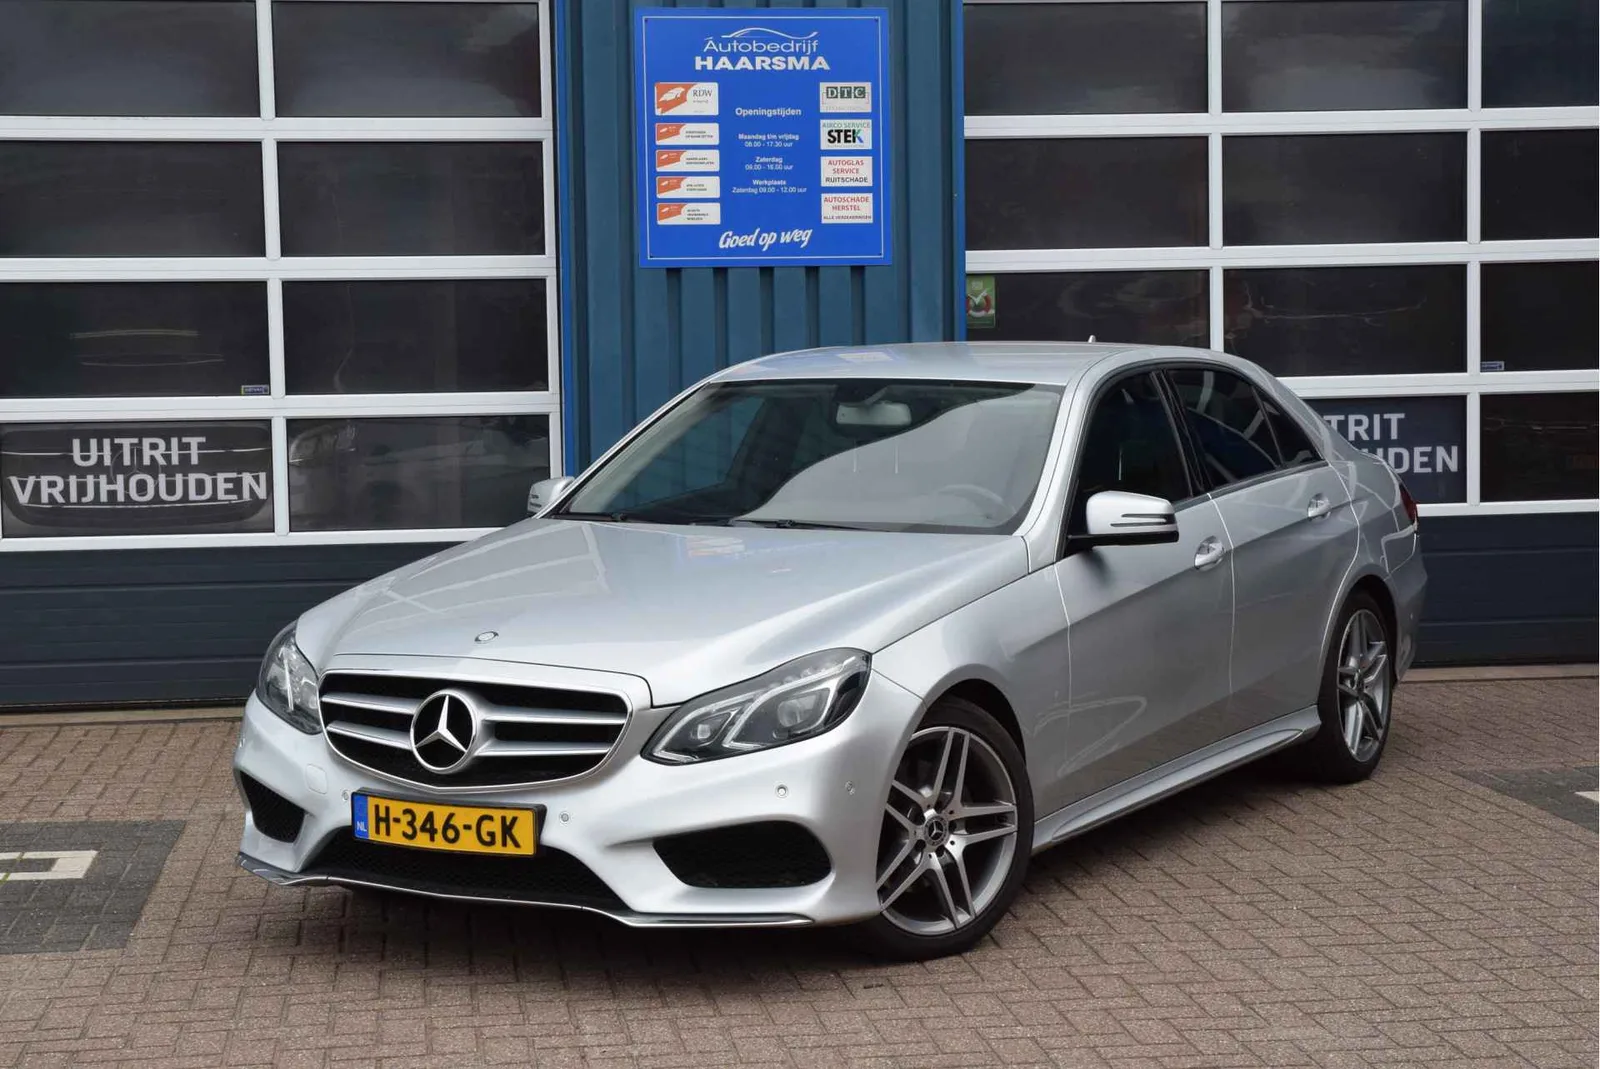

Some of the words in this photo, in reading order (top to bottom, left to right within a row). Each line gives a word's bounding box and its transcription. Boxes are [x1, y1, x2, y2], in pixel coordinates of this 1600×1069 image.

[703, 38, 819, 55] Autobedrijf
[694, 56, 831, 70] HAARSMA
[692, 89, 713, 97] RDW
[826, 86, 866, 98] DTC
[735, 107, 802, 117] Openingstijden
[827, 129, 864, 144] STEK
[719, 228, 760, 248] Goed
[759, 232, 777, 252] op
[780, 229, 813, 248] weg
[72, 436, 207, 467] UITRIT
[9, 471, 268, 504] VRIJHOUDEN
[356, 821, 368, 832] NL
[374, 803, 522, 849] H-346-GK
